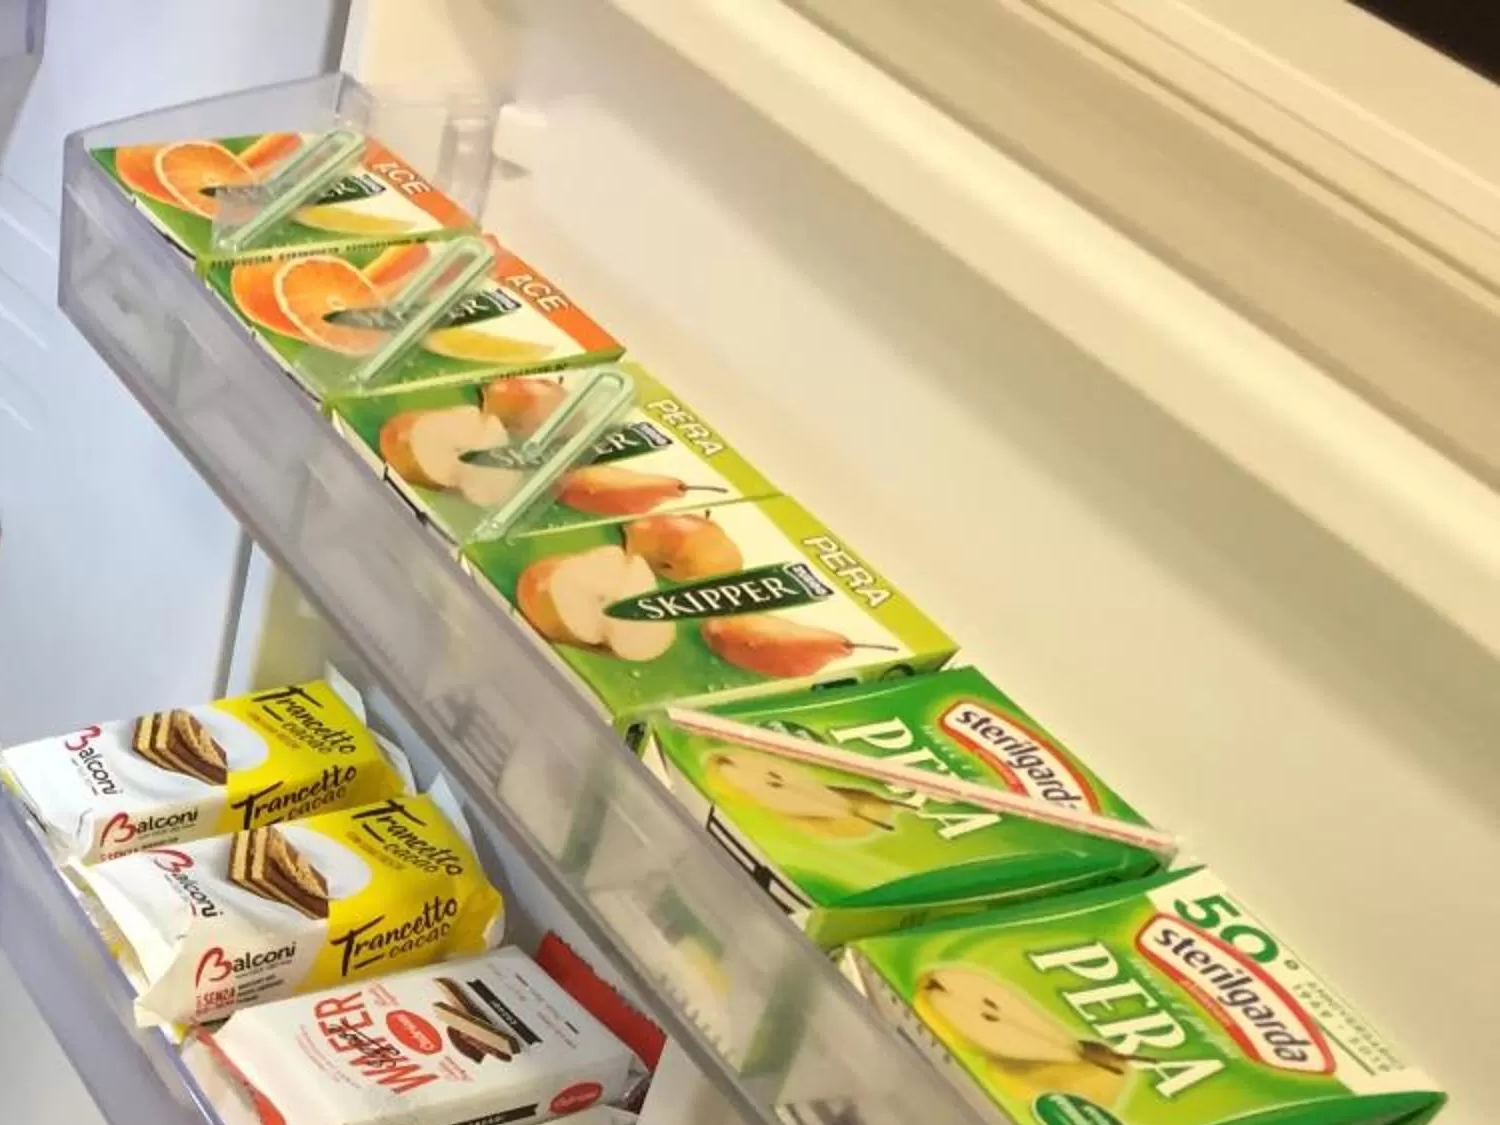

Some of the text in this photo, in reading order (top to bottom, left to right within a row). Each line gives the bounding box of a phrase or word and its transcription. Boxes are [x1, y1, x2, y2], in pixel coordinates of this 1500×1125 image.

[372, 161, 432, 195] ACE
[505, 272, 570, 313] ACE
[647, 397, 723, 459] PERA
[635, 574, 798, 622] SKIPPER
[800, 533, 896, 611] PERA
[252, 685, 357, 754] Trancetto
[282, 718, 333, 754] cacao
[65, 726, 123, 795] Balconi
[956, 711, 1084, 810] sterilgard
[100, 806, 199, 848] Balconi
[230, 764, 357, 830] Trancetto
[287, 785, 347, 821] cacao
[351, 799, 464, 876] Trancetto
[383, 843, 439, 873] cacao
[150, 848, 224, 918] Balconi
[195, 941, 297, 988] Balconi
[330, 895, 458, 977] Trancetto
[389, 923, 451, 959] cacao
[1029, 941, 1228, 1099] PERA
[1154, 925, 1311, 1062] sterilgarda
[314, 990, 440, 1095] WAFER
